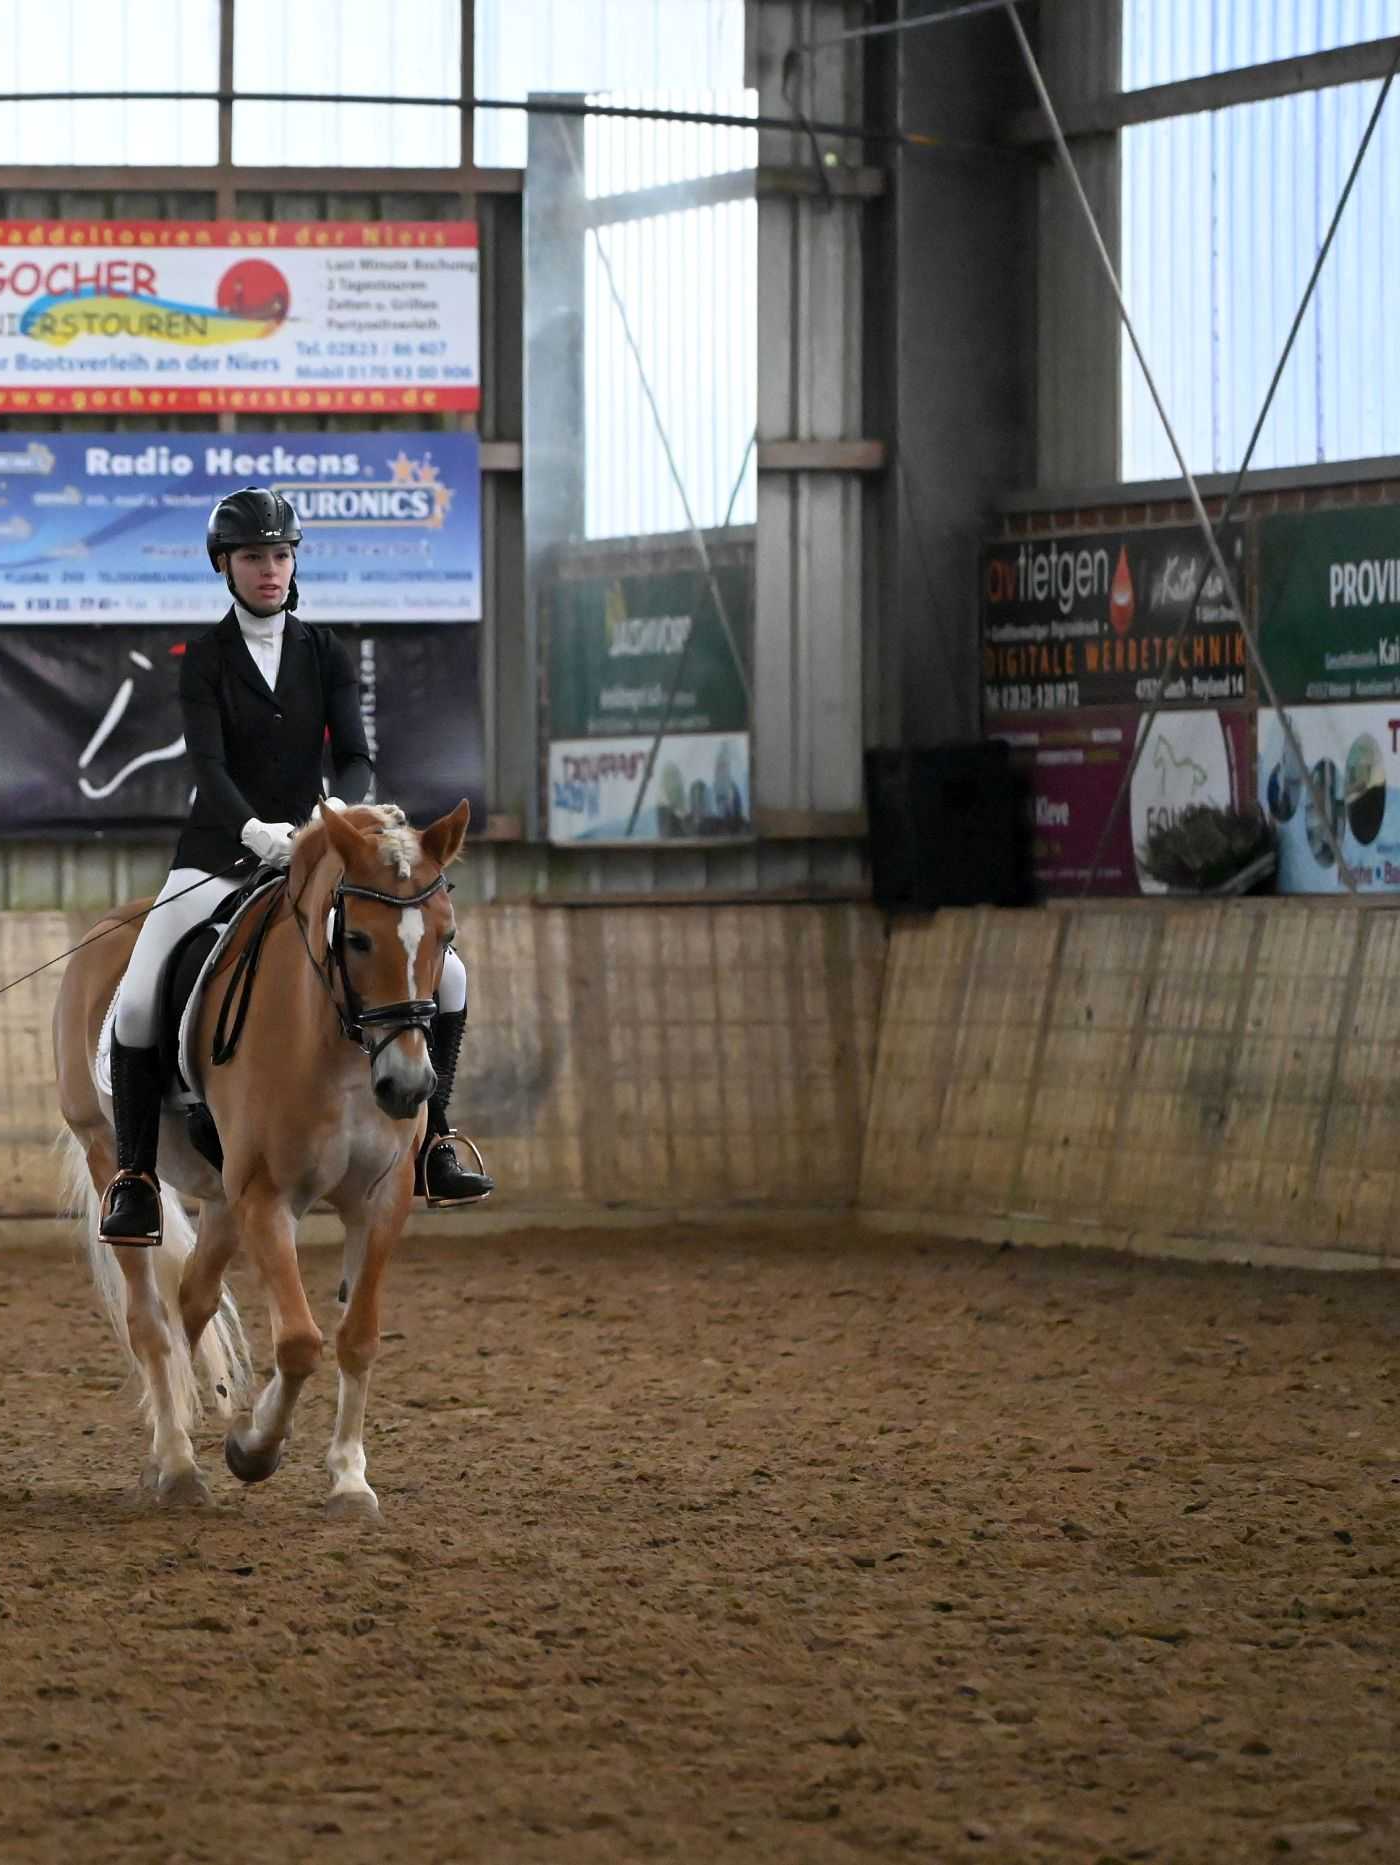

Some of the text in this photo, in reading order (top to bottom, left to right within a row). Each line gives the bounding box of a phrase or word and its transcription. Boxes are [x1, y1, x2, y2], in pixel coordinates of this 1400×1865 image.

[299, 226, 347, 246] der
[361, 227, 449, 247] Niers
[13, 353, 152, 373] Bootsverleih
[155, 358, 181, 372] an
[185, 354, 221, 373] der
[226, 355, 281, 373] Niers
[86, 446, 359, 476] Radio Heckens
[1330, 557, 1400, 608] PROVI
[985, 634, 1245, 677] DIGITALE WERBETECHNIK
